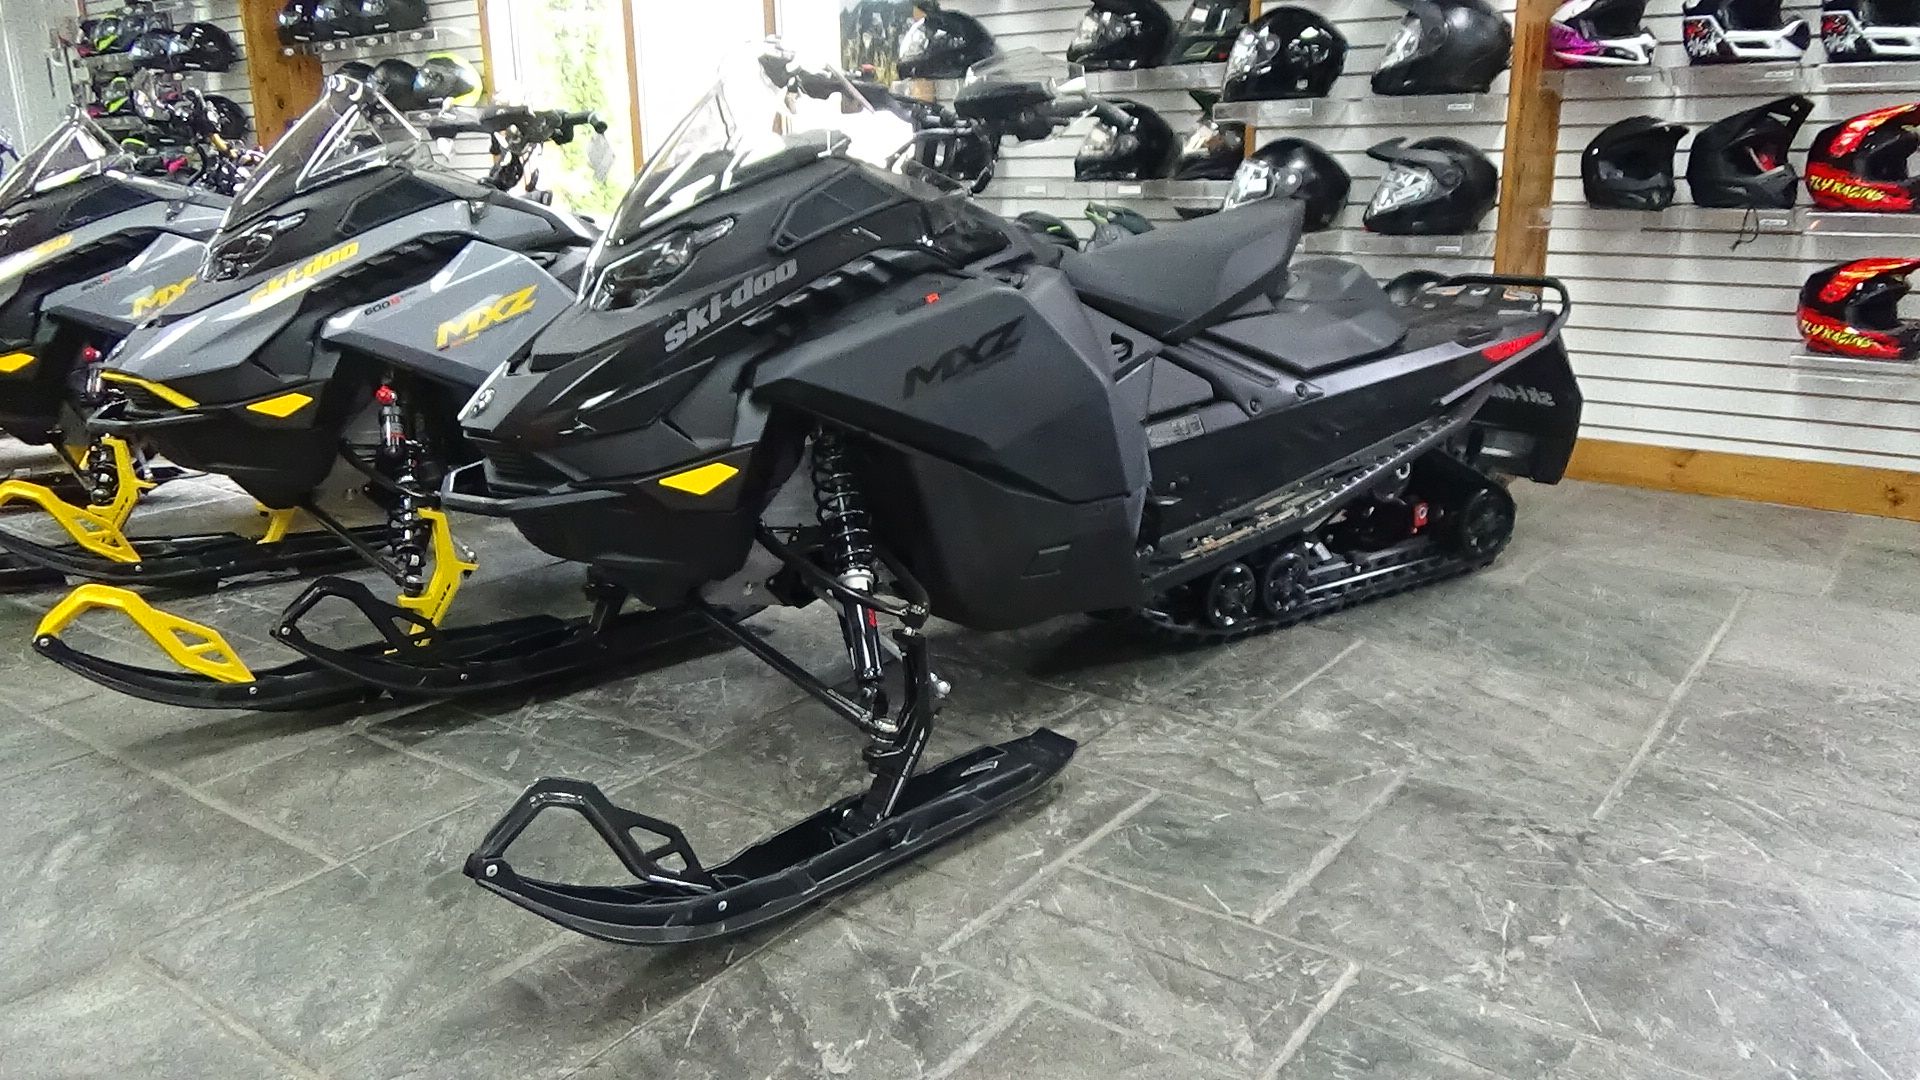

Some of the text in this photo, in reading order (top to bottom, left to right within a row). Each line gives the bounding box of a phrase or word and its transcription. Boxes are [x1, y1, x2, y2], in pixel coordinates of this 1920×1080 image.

[436, 284, 537, 351] MXZ
[664, 258, 798, 352] ski-doo
[902, 314, 1025, 400] MXZ
